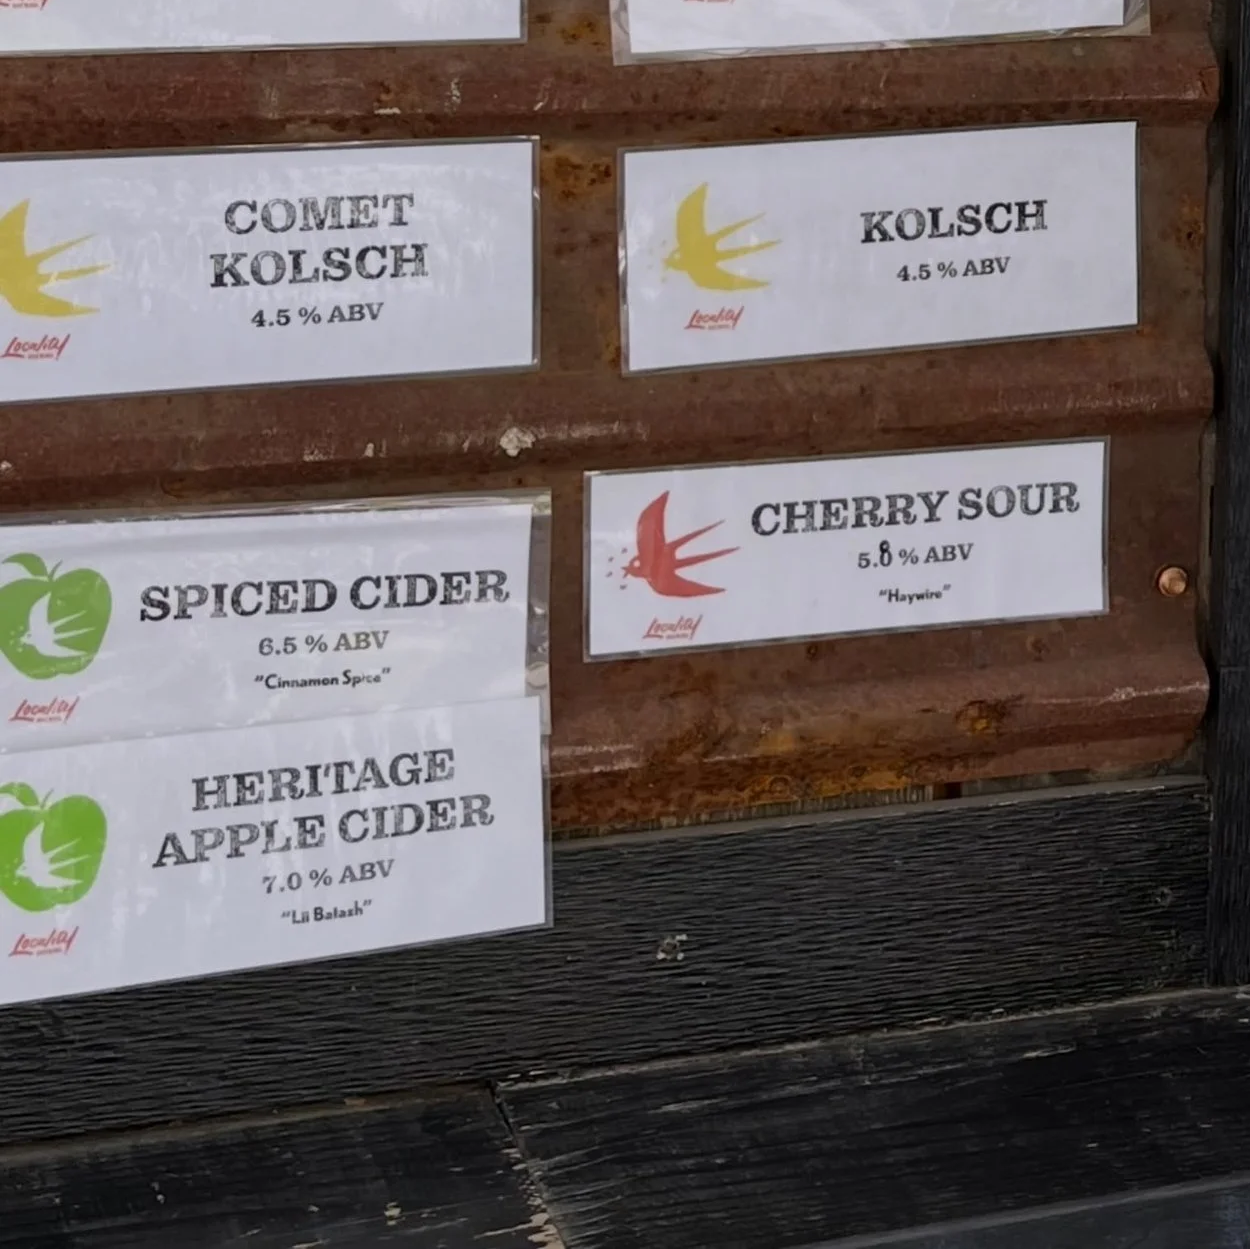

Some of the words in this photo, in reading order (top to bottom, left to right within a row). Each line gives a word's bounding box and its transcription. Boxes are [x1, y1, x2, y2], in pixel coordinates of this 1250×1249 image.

[223, 192, 415, 236] COMET
[859, 199, 1048, 245] KOLSCH
[209, 242, 429, 289] KOLSCH
[896, 263, 932, 283] 4.5
[936, 260, 959, 279] %
[962, 255, 1012, 278] ABV
[250, 308, 292, 328] 4.5
[297, 305, 323, 326] %
[326, 301, 385, 324] ABV
[750, 489, 950, 537] CHERRY
[957, 481, 1081, 522] SOUR
[897, 547, 920, 567] %
[923, 542, 974, 565] ABV
[139, 578, 338, 623] SPICED
[349, 569, 511, 611] CIDER
[258, 636, 298, 657] 6.5
[303, 633, 329, 654] %
[332, 629, 391, 653] ABV
[191, 748, 456, 813] HERITAGE
[151, 813, 327, 870] APPLE
[337, 792, 495, 844] CIDER
[261, 871, 303, 895] 7.0
[308, 867, 333, 889] %
[338, 858, 396, 885] ABV
